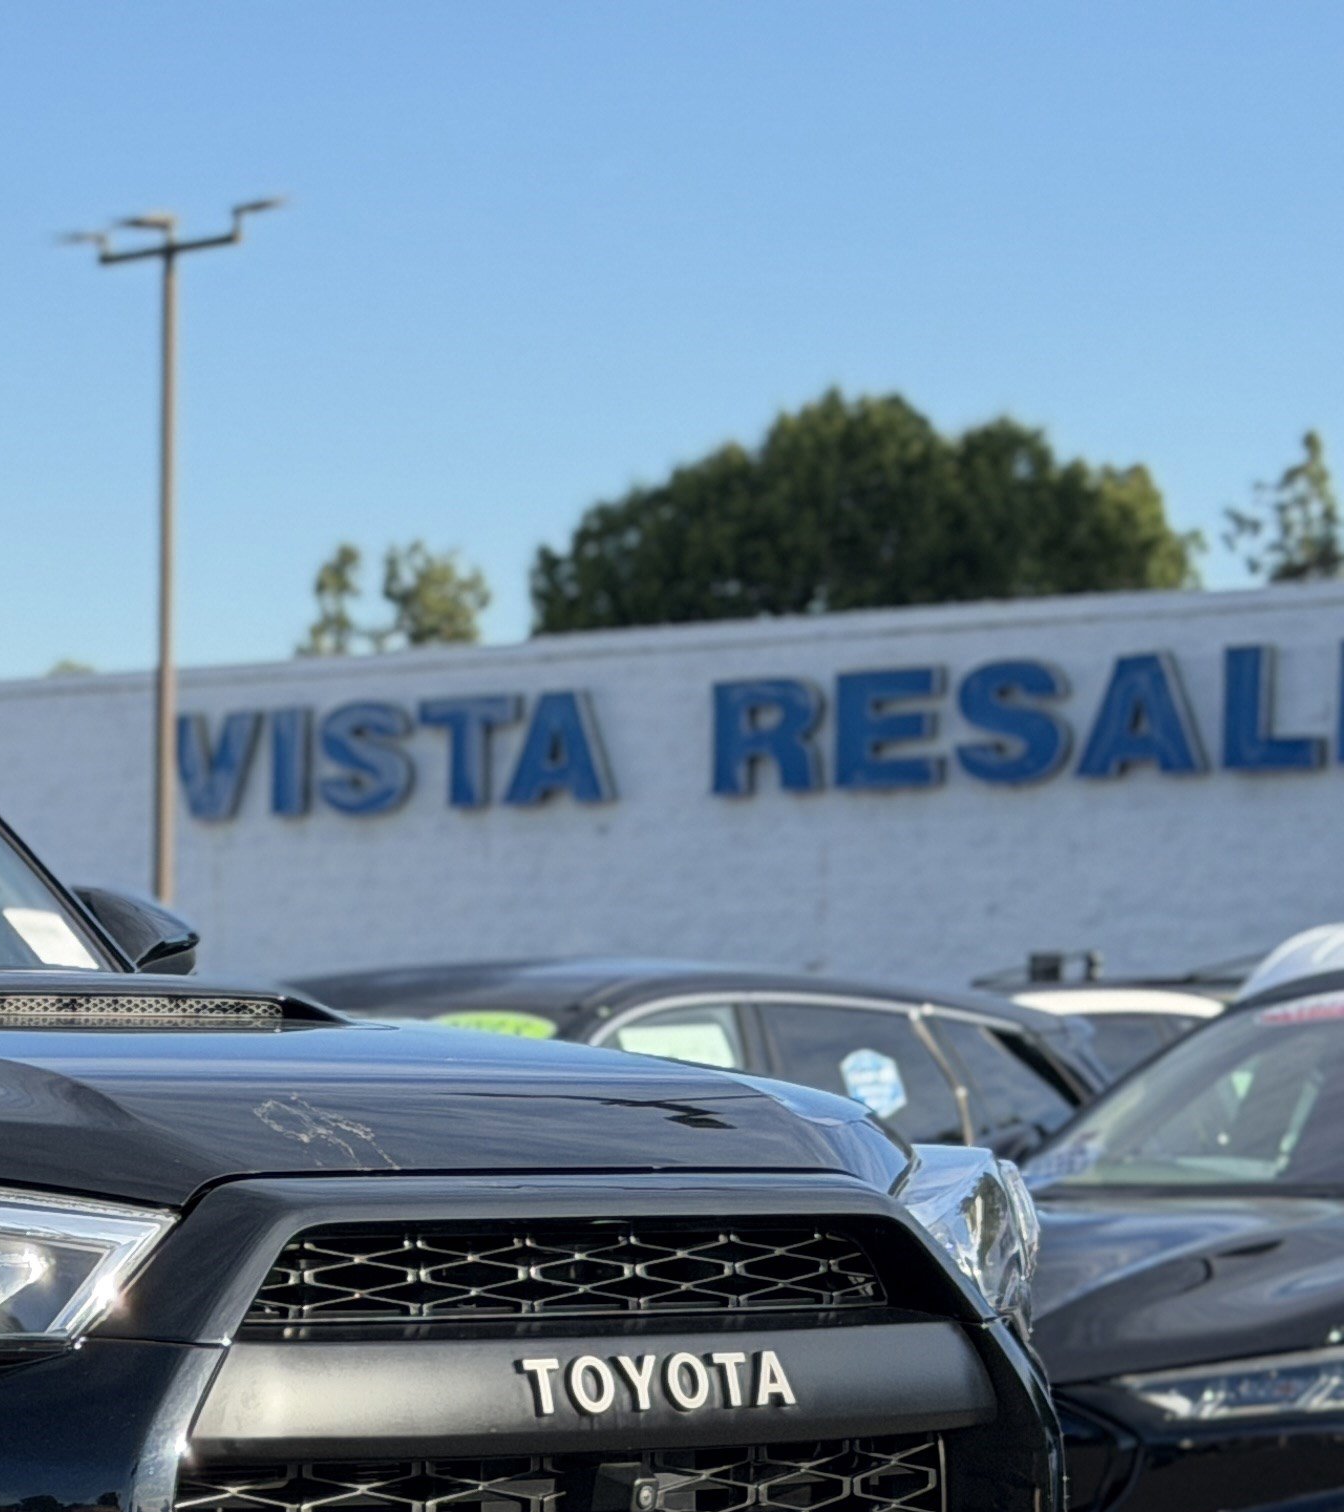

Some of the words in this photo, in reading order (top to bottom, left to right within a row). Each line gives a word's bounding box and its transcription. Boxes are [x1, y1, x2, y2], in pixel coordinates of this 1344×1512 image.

[173, 689, 617, 823] VISTA
[712, 640, 1344, 799] RESAL
[521, 1350, 797, 1415] TOYOTA
